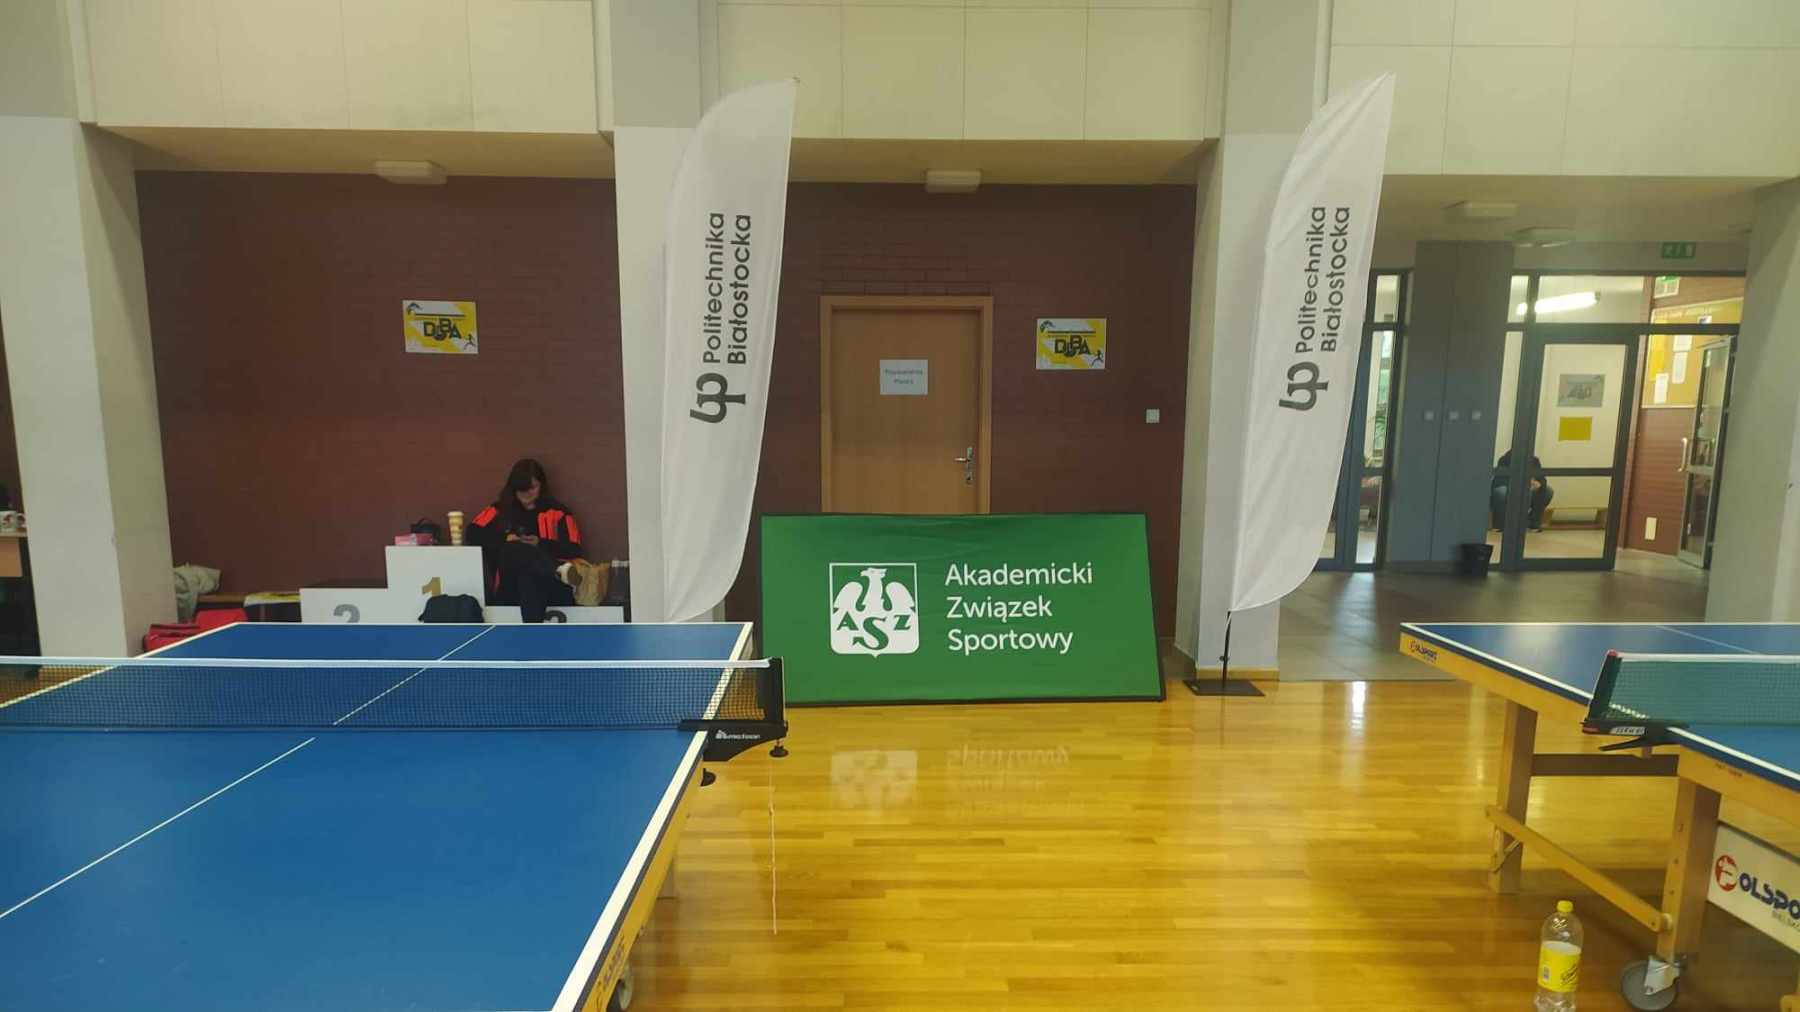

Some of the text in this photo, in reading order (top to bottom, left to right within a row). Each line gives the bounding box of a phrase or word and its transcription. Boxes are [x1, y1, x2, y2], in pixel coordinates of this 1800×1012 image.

[703, 212, 724, 364] Politechnika
[727, 214, 751, 365] Białostocka
[1295, 206, 1326, 354] Politechnika
[1320, 207, 1350, 353] Białostocka
[945, 561, 1093, 586] Akademicki
[946, 595, 1053, 623] Związek
[948, 628, 1074, 656] Sportowy
